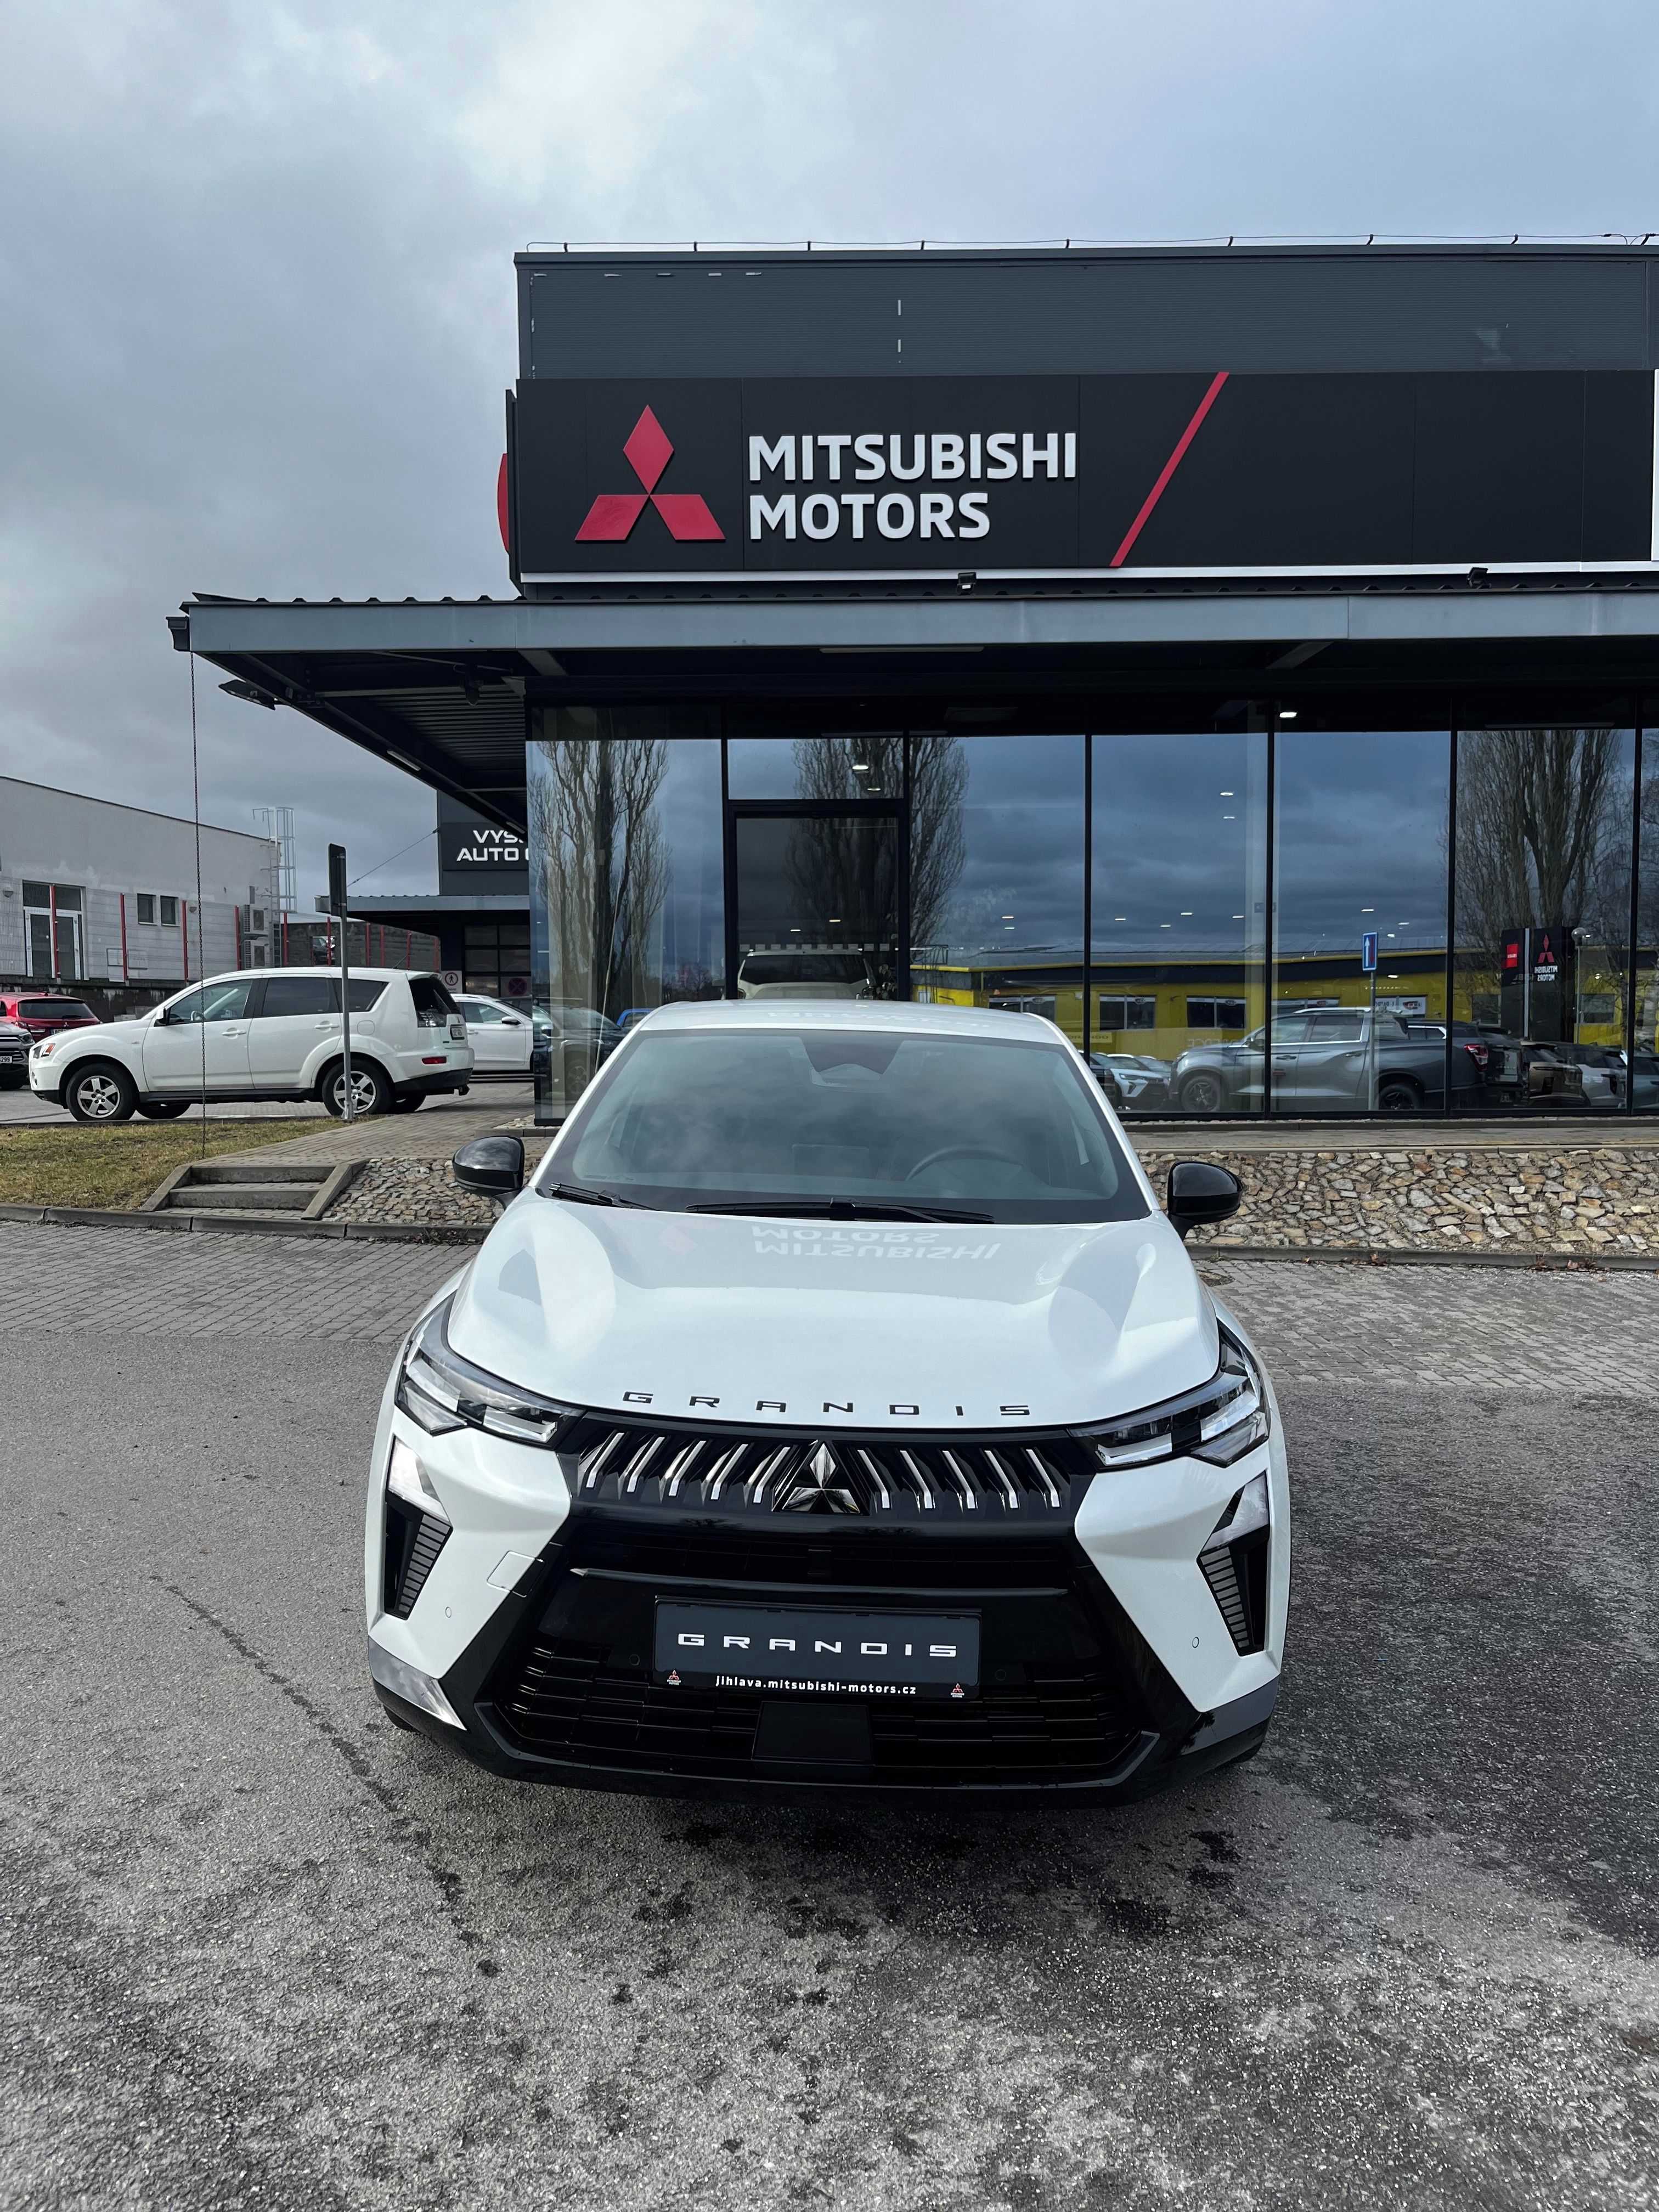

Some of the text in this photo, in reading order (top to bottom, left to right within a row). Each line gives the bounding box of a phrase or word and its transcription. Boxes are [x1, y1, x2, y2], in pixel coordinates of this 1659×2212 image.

[749, 433, 1077, 482] MITSUBISHI
[749, 493, 990, 540] MOTORS
[473, 830, 524, 843] VYS
[456, 848, 519, 861] AUTO
[623, 1391, 1030, 1417] GRANDIS
[678, 1633, 957, 1658] GRANDIS
[715, 1675, 916, 1695] jihlava.mitsubishi-motors.cz
